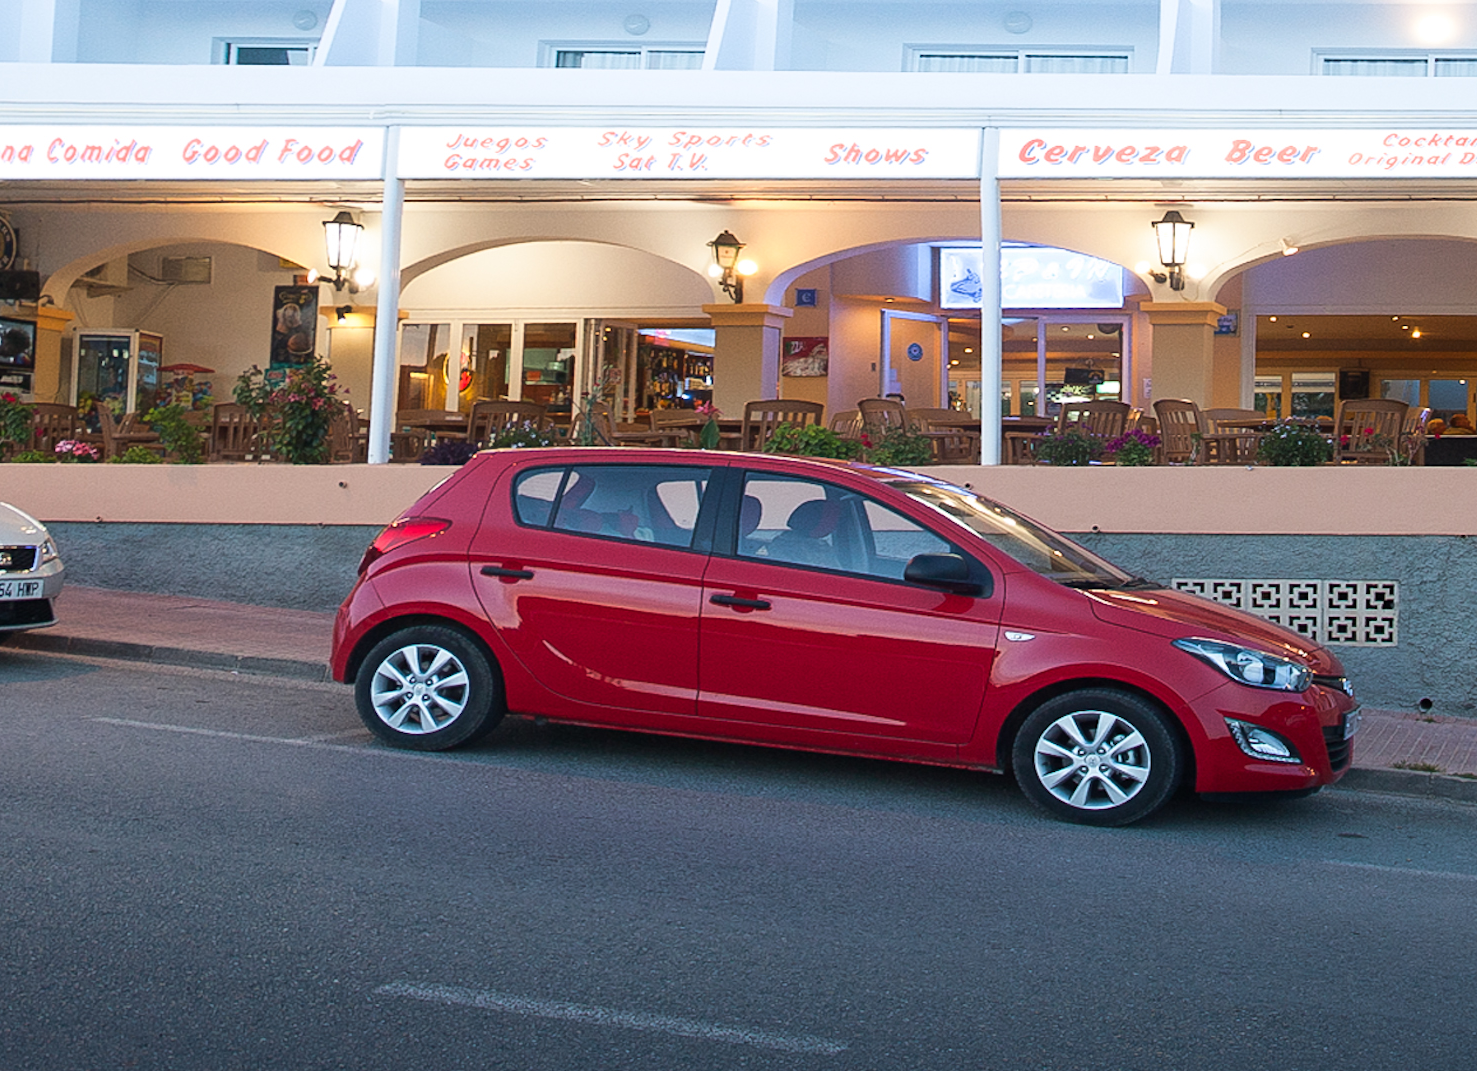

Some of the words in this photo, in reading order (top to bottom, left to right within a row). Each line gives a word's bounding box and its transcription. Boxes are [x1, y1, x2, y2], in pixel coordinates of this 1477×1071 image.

[46, 137, 153, 165] Comida
[182, 138, 268, 165] Good
[277, 138, 364, 165] Food
[446, 133, 549, 155] Juegos
[597, 131, 652, 151] Sky
[667, 131, 774, 151] Sports
[443, 153, 537, 172] Games
[613, 152, 656, 171] Sat
[824, 143, 928, 166] Shows
[1018, 138, 1191, 166] Cerveza
[1224, 139, 1321, 165] Beer
[1348, 151, 1450, 171] Original
[17, 581, 39, 598] HWP
